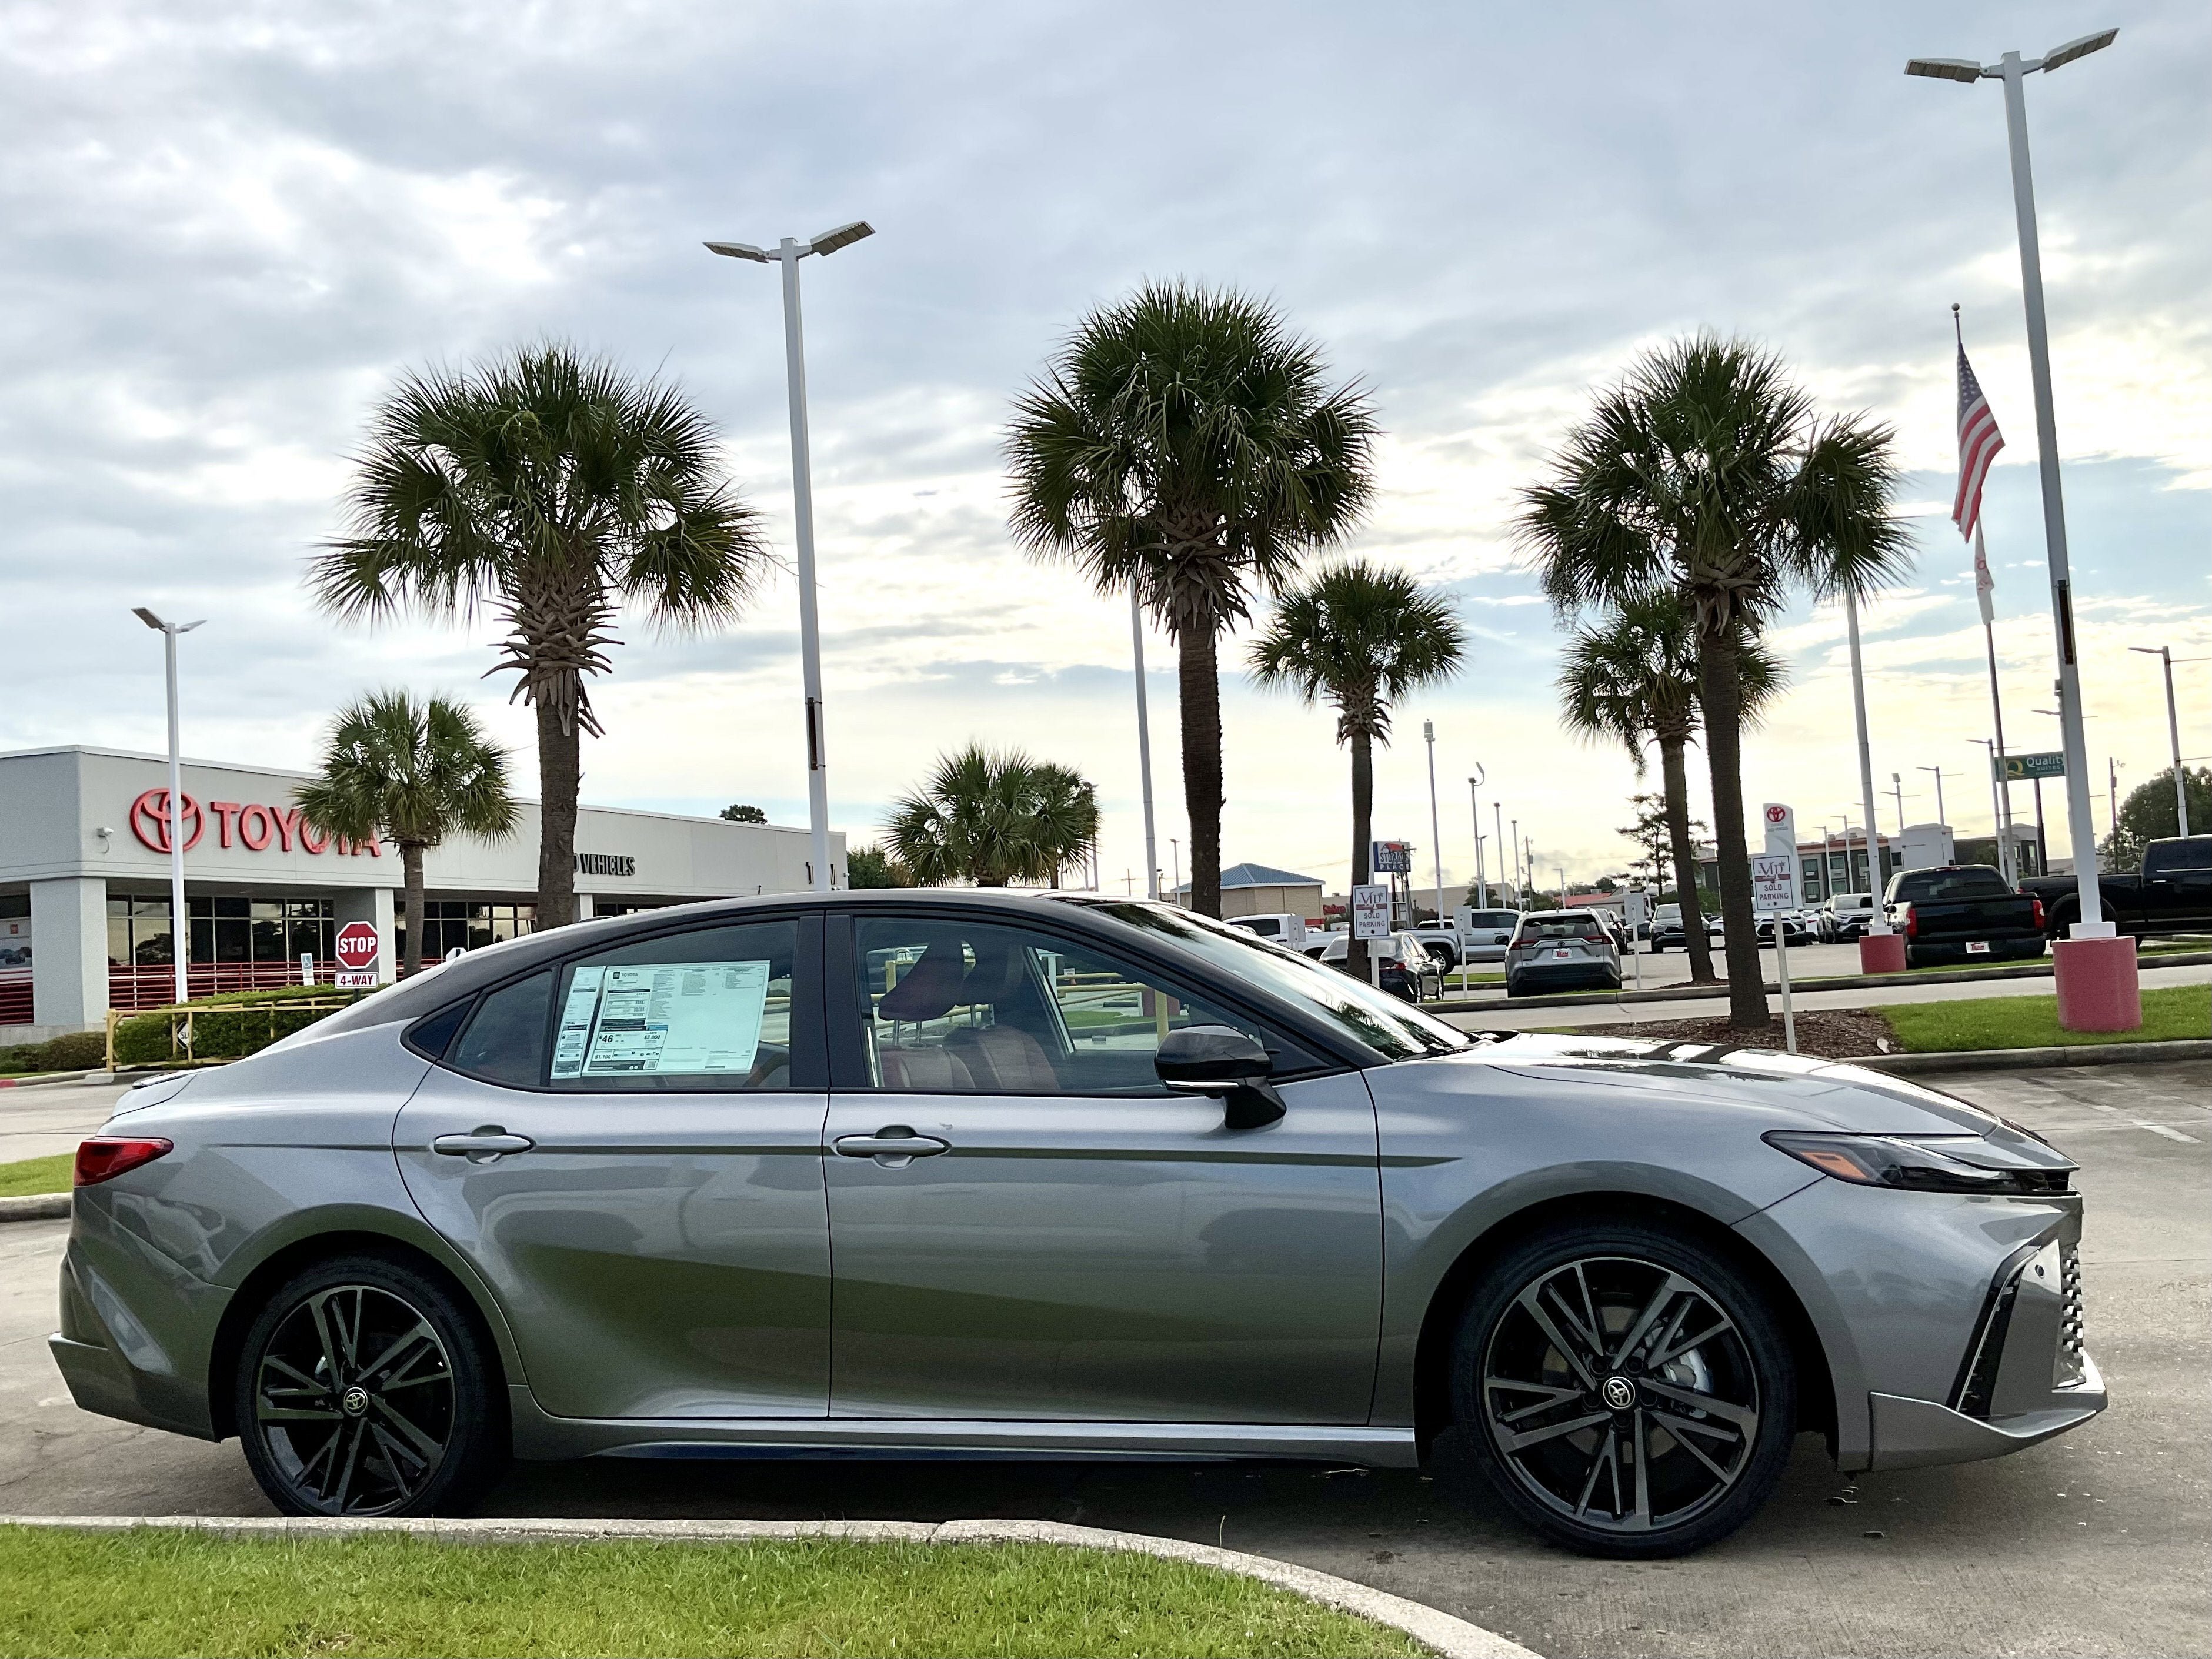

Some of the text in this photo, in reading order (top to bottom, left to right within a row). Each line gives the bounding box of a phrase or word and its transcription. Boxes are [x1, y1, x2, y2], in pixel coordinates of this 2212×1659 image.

[2026, 756, 2064, 768] Quality
[210, 802, 382, 857] TOYOA
[1380, 852, 1409, 863] STORAE
[579, 853, 636, 876] VEHICLES
[1759, 893, 1789, 901] PARKING
[339, 937, 376, 954] STOP
[340, 974, 373, 985] 4-WAY
[602, 1034, 614, 1043] 46
